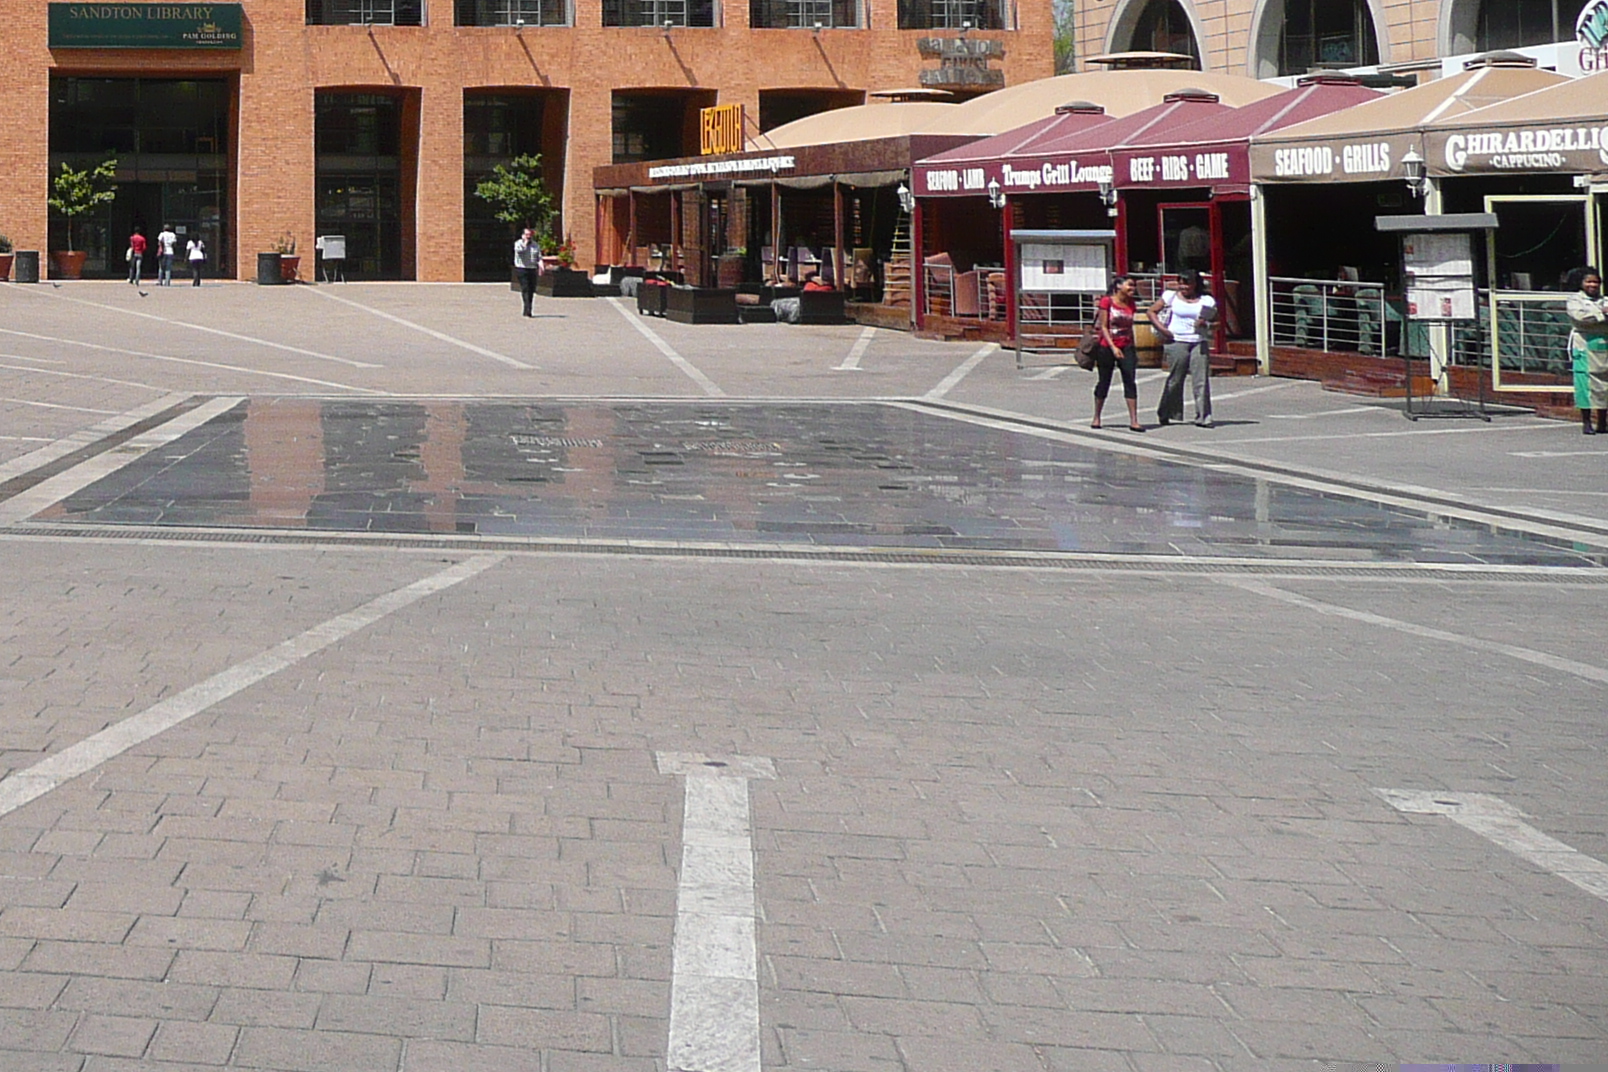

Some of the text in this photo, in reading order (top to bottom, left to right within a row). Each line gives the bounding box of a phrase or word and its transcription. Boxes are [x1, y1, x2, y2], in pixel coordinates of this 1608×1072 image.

[69, 6, 214, 20] SANDTON LIBRARY
[182, 32, 198, 40] PAM
[200, 32, 237, 40] GOLDING
[1130, 153, 1229, 182] BEEF RIBS GAME
[1275, 142, 1390, 177] SEAFOOD GRILLS
[1493, 153, 1560, 168] CAPPUCINO
[926, 168, 985, 191] SEAFOOD LAMB
[1002, 159, 1113, 190] Trumps Grill Lounge
